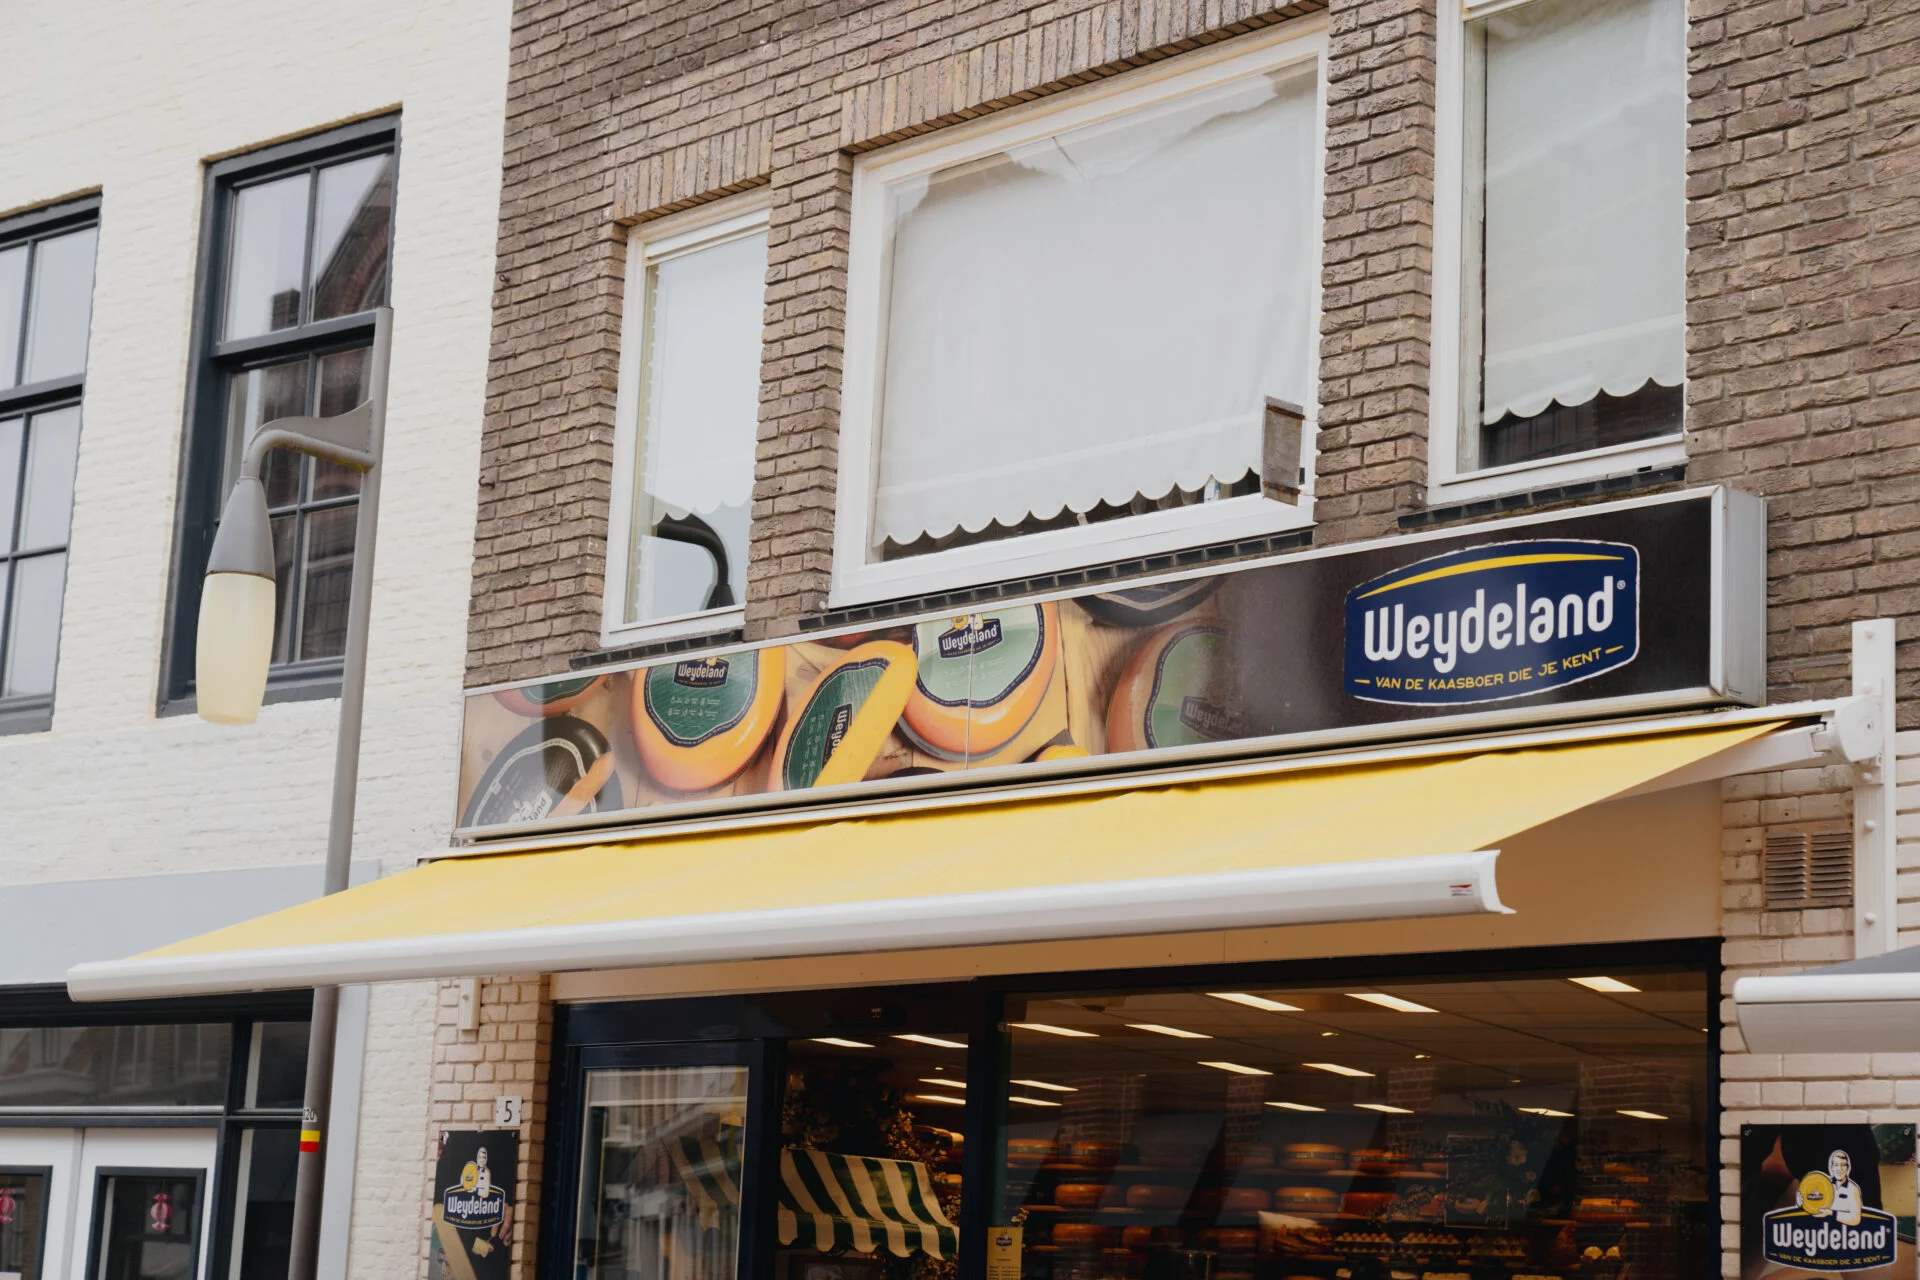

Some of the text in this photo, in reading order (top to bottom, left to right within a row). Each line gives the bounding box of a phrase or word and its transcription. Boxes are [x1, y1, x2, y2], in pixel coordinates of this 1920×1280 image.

[678, 664, 726, 682] Weydeland
[1375, 647, 1602, 691] VAN DE KAASBOER DIE JE KENT
[503, 1100, 513, 1123] 5
[447, 1196, 500, 1219] Weydeland
[1772, 1222, 1886, 1257] Weydeland
